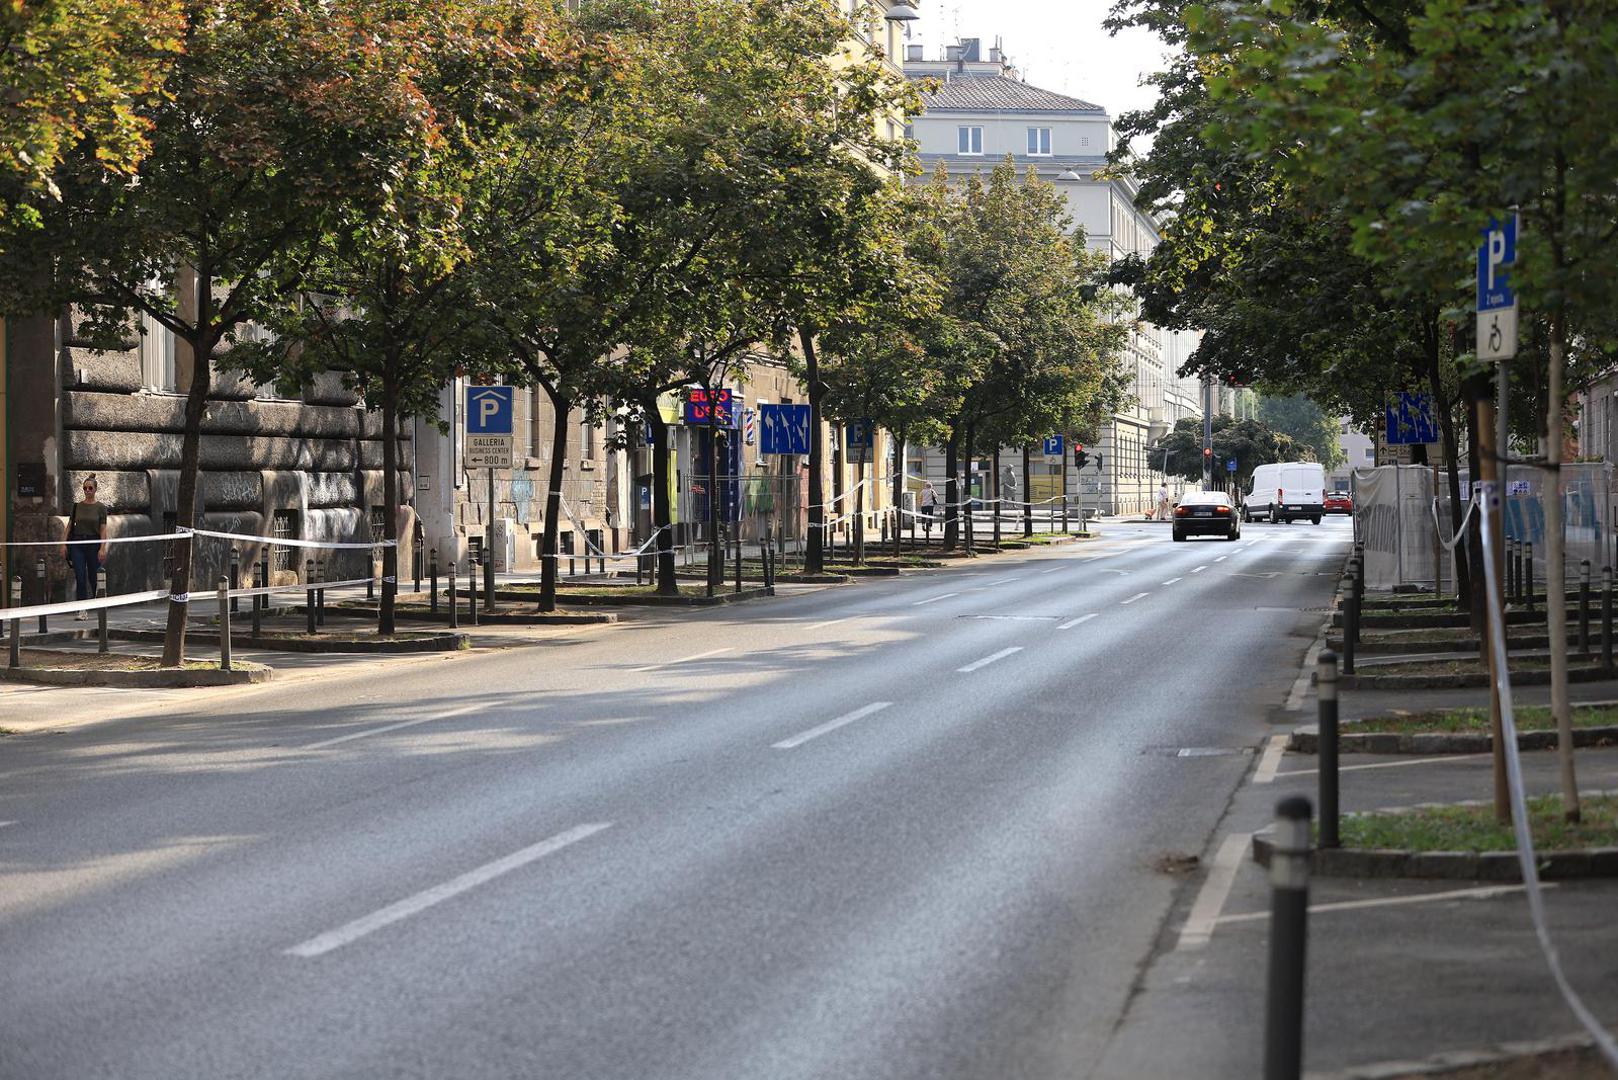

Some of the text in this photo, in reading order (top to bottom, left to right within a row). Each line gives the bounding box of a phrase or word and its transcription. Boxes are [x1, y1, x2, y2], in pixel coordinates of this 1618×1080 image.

[1488, 230, 1505, 290] P
[480, 398, 499, 427] P
[473, 438, 505, 446] GALLERIA
[1049, 438, 1058, 451] P
[484, 456, 499, 465] 800
[641, 487, 648, 496] P
